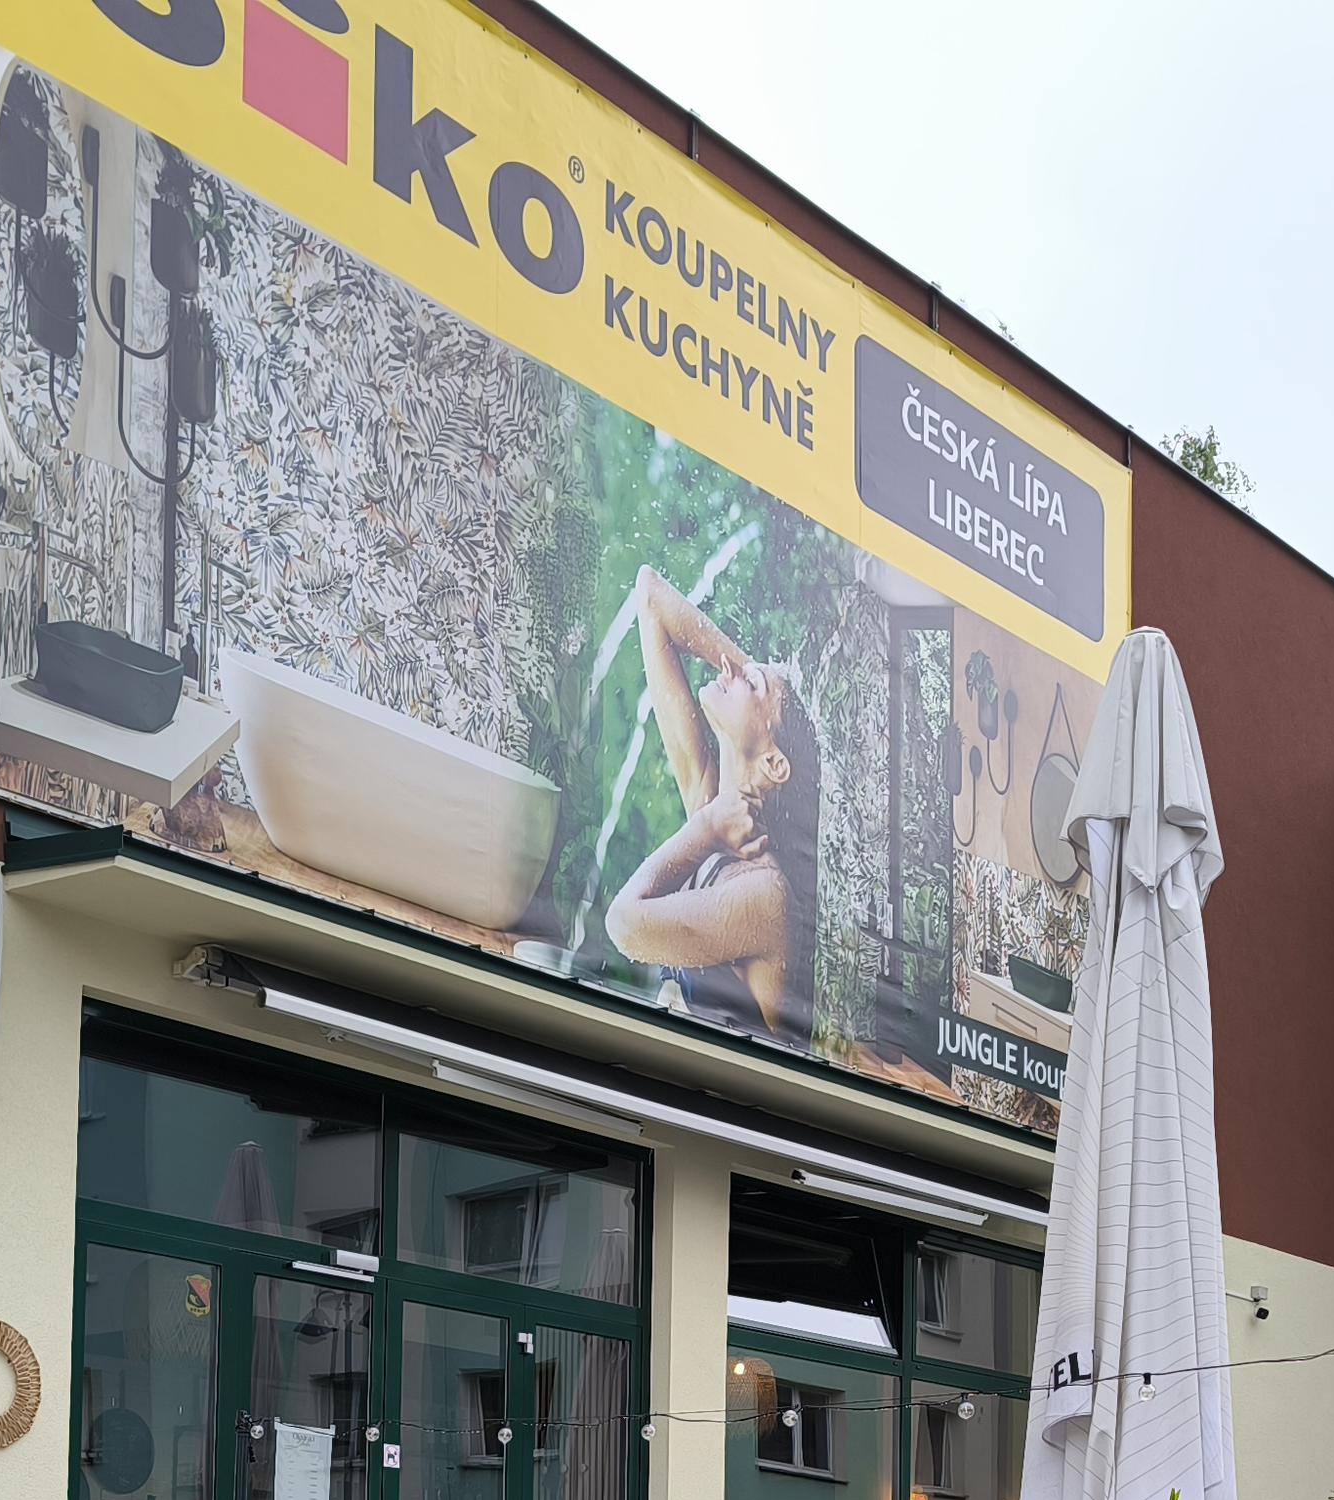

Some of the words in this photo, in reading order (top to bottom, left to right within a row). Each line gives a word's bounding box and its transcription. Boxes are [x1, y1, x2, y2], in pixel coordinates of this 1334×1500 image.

[605, 179, 836, 373] KOUPELNY
[604, 273, 814, 451] KUCHYNĚ
[901, 382, 1001, 493] ČESKÁ
[1008, 460, 1068, 536] LÍPA
[928, 477, 1045, 586] LIBEREC
[937, 1017, 1018, 1075] JUNGLE
